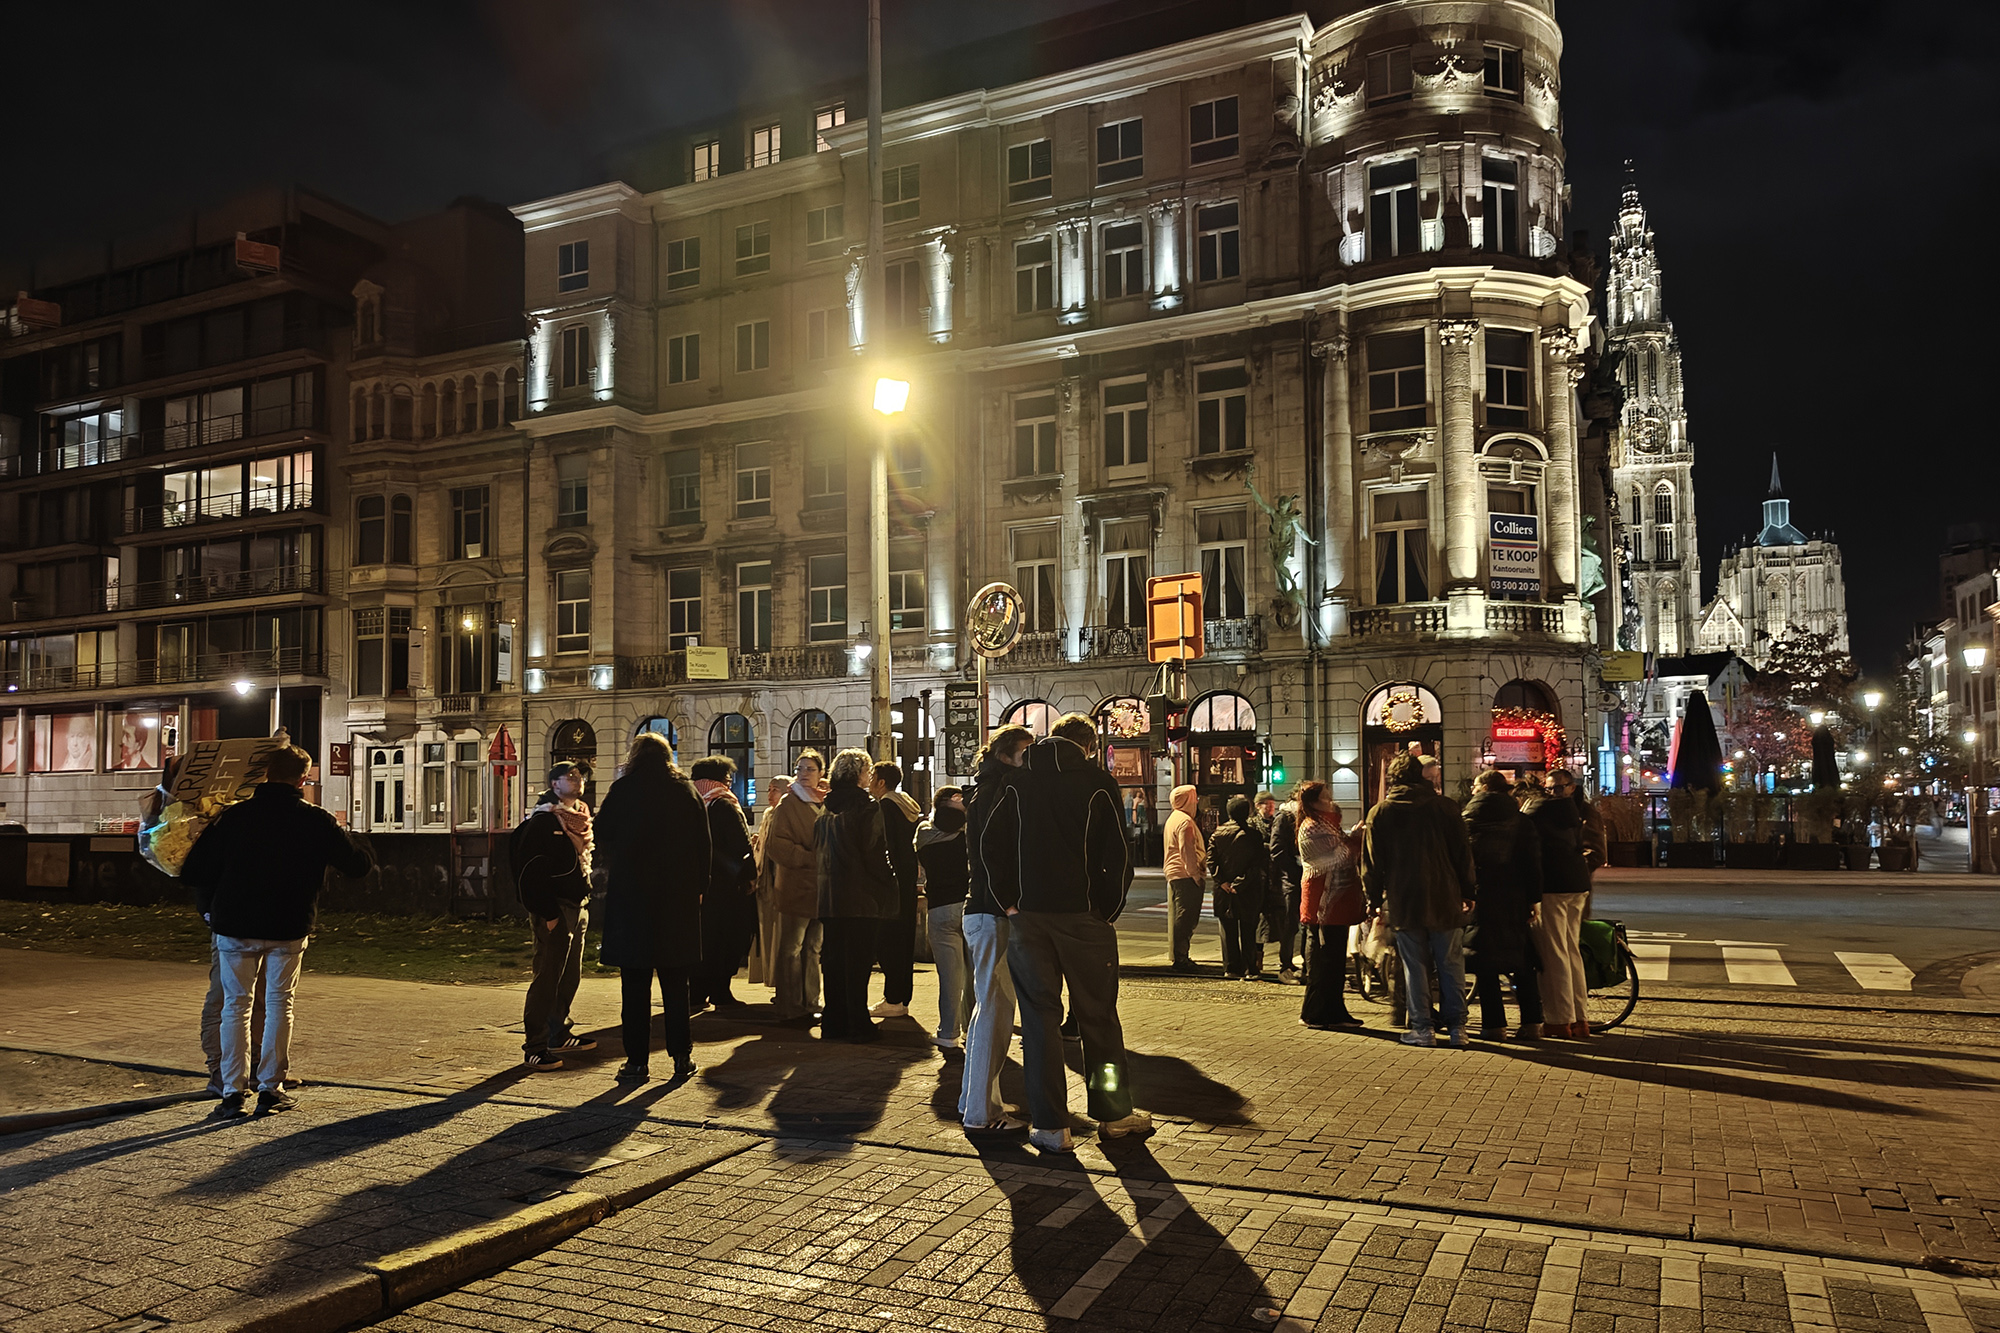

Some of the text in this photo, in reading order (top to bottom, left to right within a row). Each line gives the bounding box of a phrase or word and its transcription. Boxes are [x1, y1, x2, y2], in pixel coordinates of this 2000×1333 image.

[1494, 520, 1534, 535] Colliers
[1491, 549, 1538, 562] TE KOOP
[1493, 564, 1535, 574] Kantoorunits
[1491, 580, 1540, 592] 03 500 20 20
[332, 745, 342, 758] R
